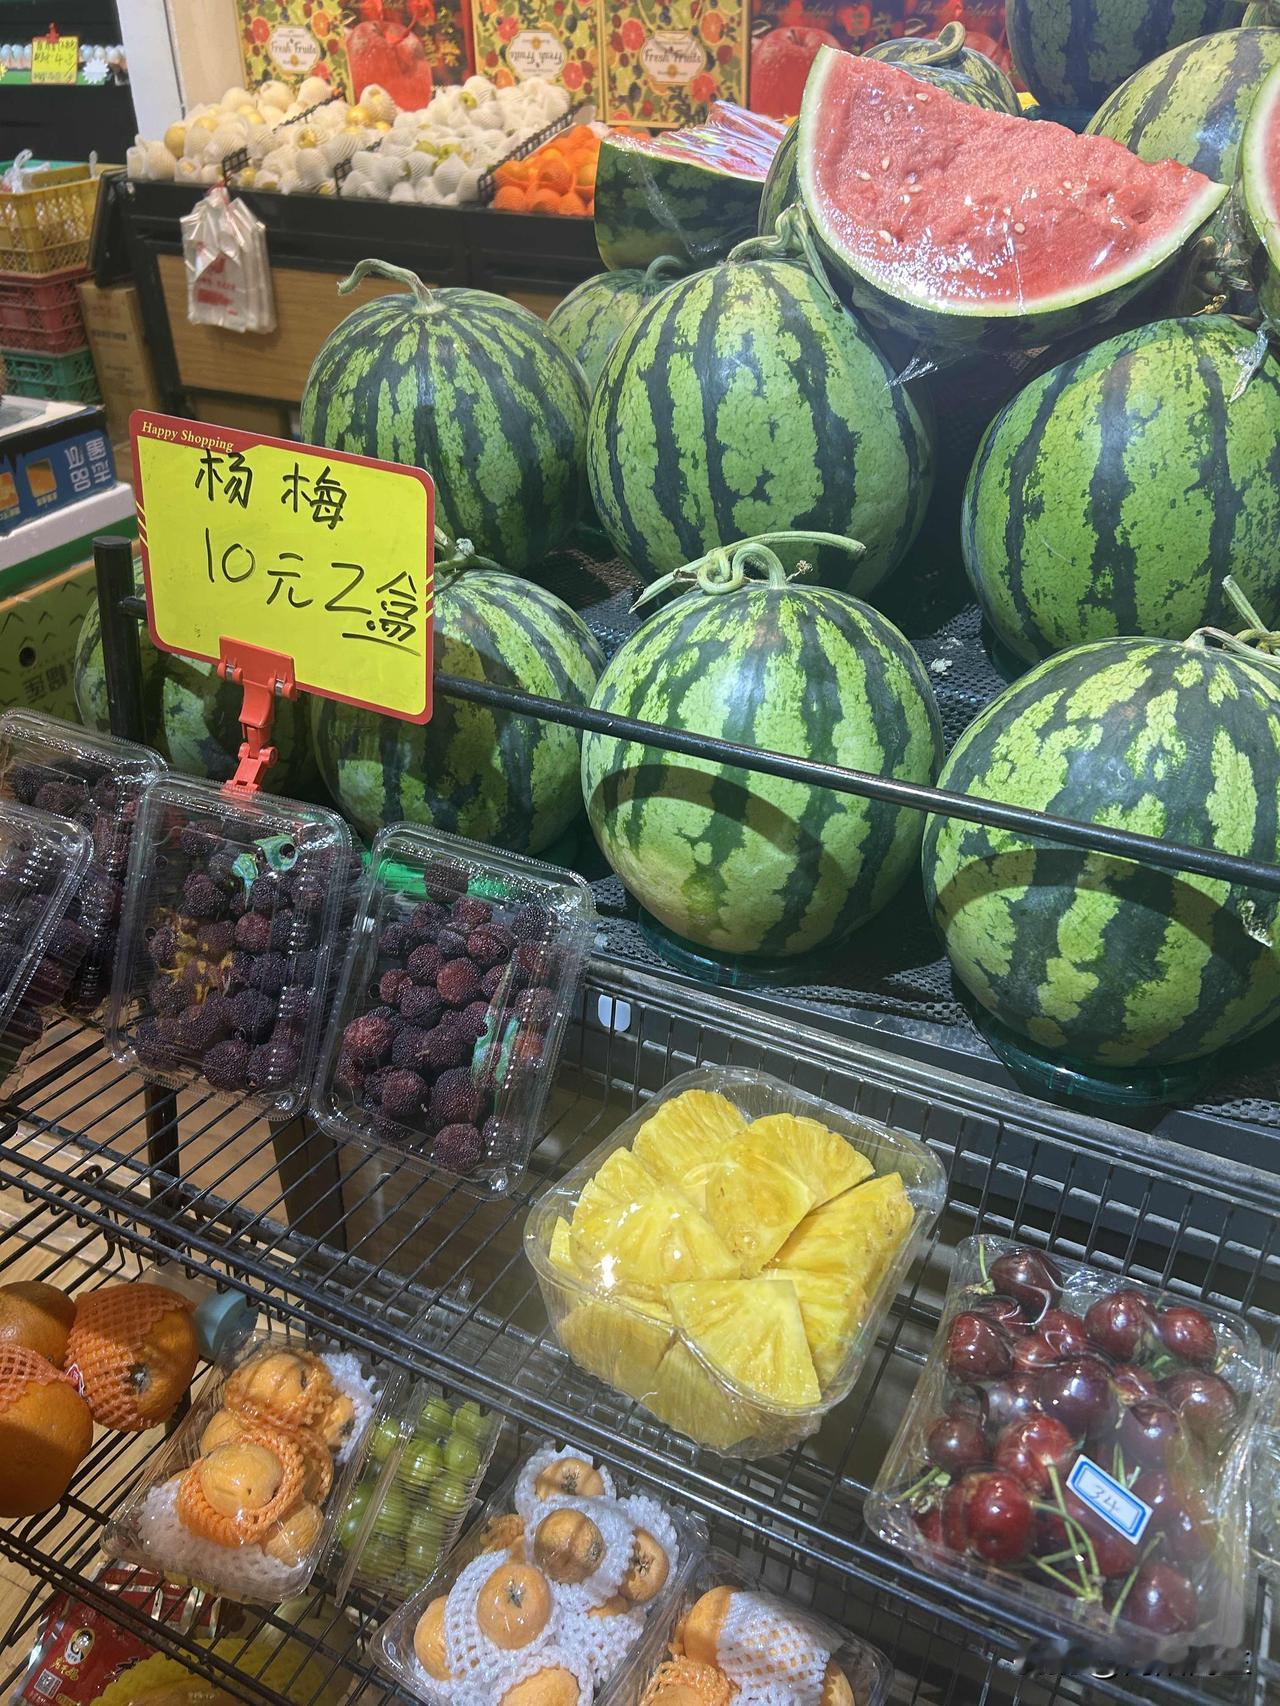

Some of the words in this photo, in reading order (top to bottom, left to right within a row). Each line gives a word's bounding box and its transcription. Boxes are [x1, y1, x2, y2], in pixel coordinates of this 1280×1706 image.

[271, 40, 292, 54] Fresh
[294, 41, 317, 54] Fruits
[538, 52, 562, 65] Fresh
[644, 48, 670, 63] Fresh
[141, 420, 179, 442] Happy
[180, 428, 235, 452] Shopping
[194, 448, 348, 530] 杨梅
